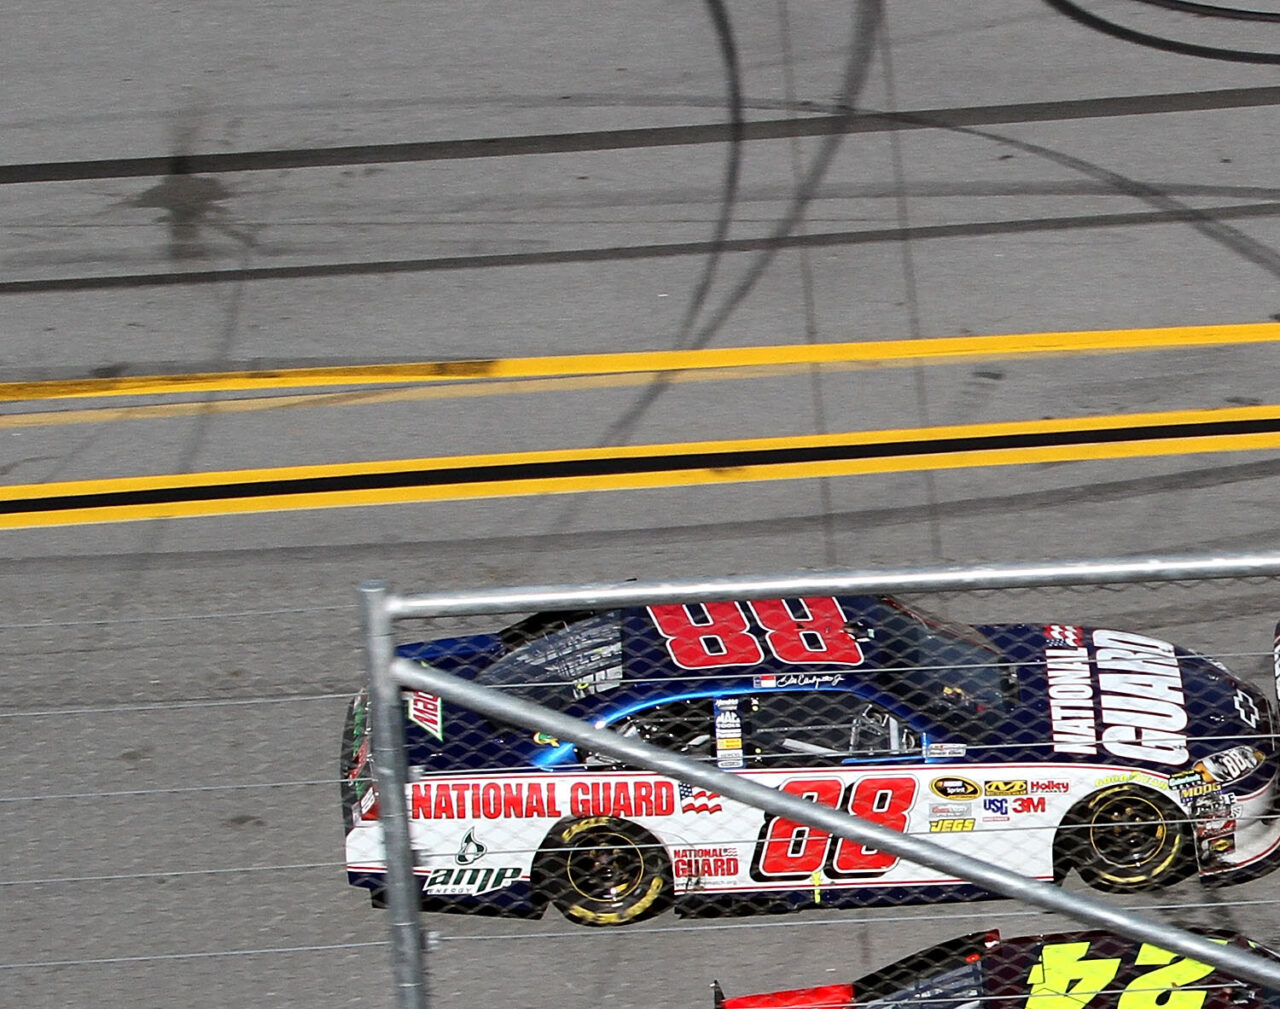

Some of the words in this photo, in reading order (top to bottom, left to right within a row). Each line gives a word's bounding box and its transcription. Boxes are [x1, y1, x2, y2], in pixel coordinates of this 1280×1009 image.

[647, 597, 865, 670] 88
[1045, 646, 1098, 754] NATIONAL
[1091, 628, 1190, 766] GUARD
[1224, 750, 1246, 778] 88
[1030, 781, 1070, 793] Holley
[1180, 782, 1222, 799] MOOG
[411, 782, 562, 819] NATIONAL
[570, 780, 675, 818] GUARD
[983, 797, 1009, 816] USG
[1012, 796, 1046, 813] 3M
[757, 775, 921, 877] 88
[929, 817, 976, 833] JEGS
[673, 847, 724, 860] NATIONAL
[673, 857, 739, 878] GUARD
